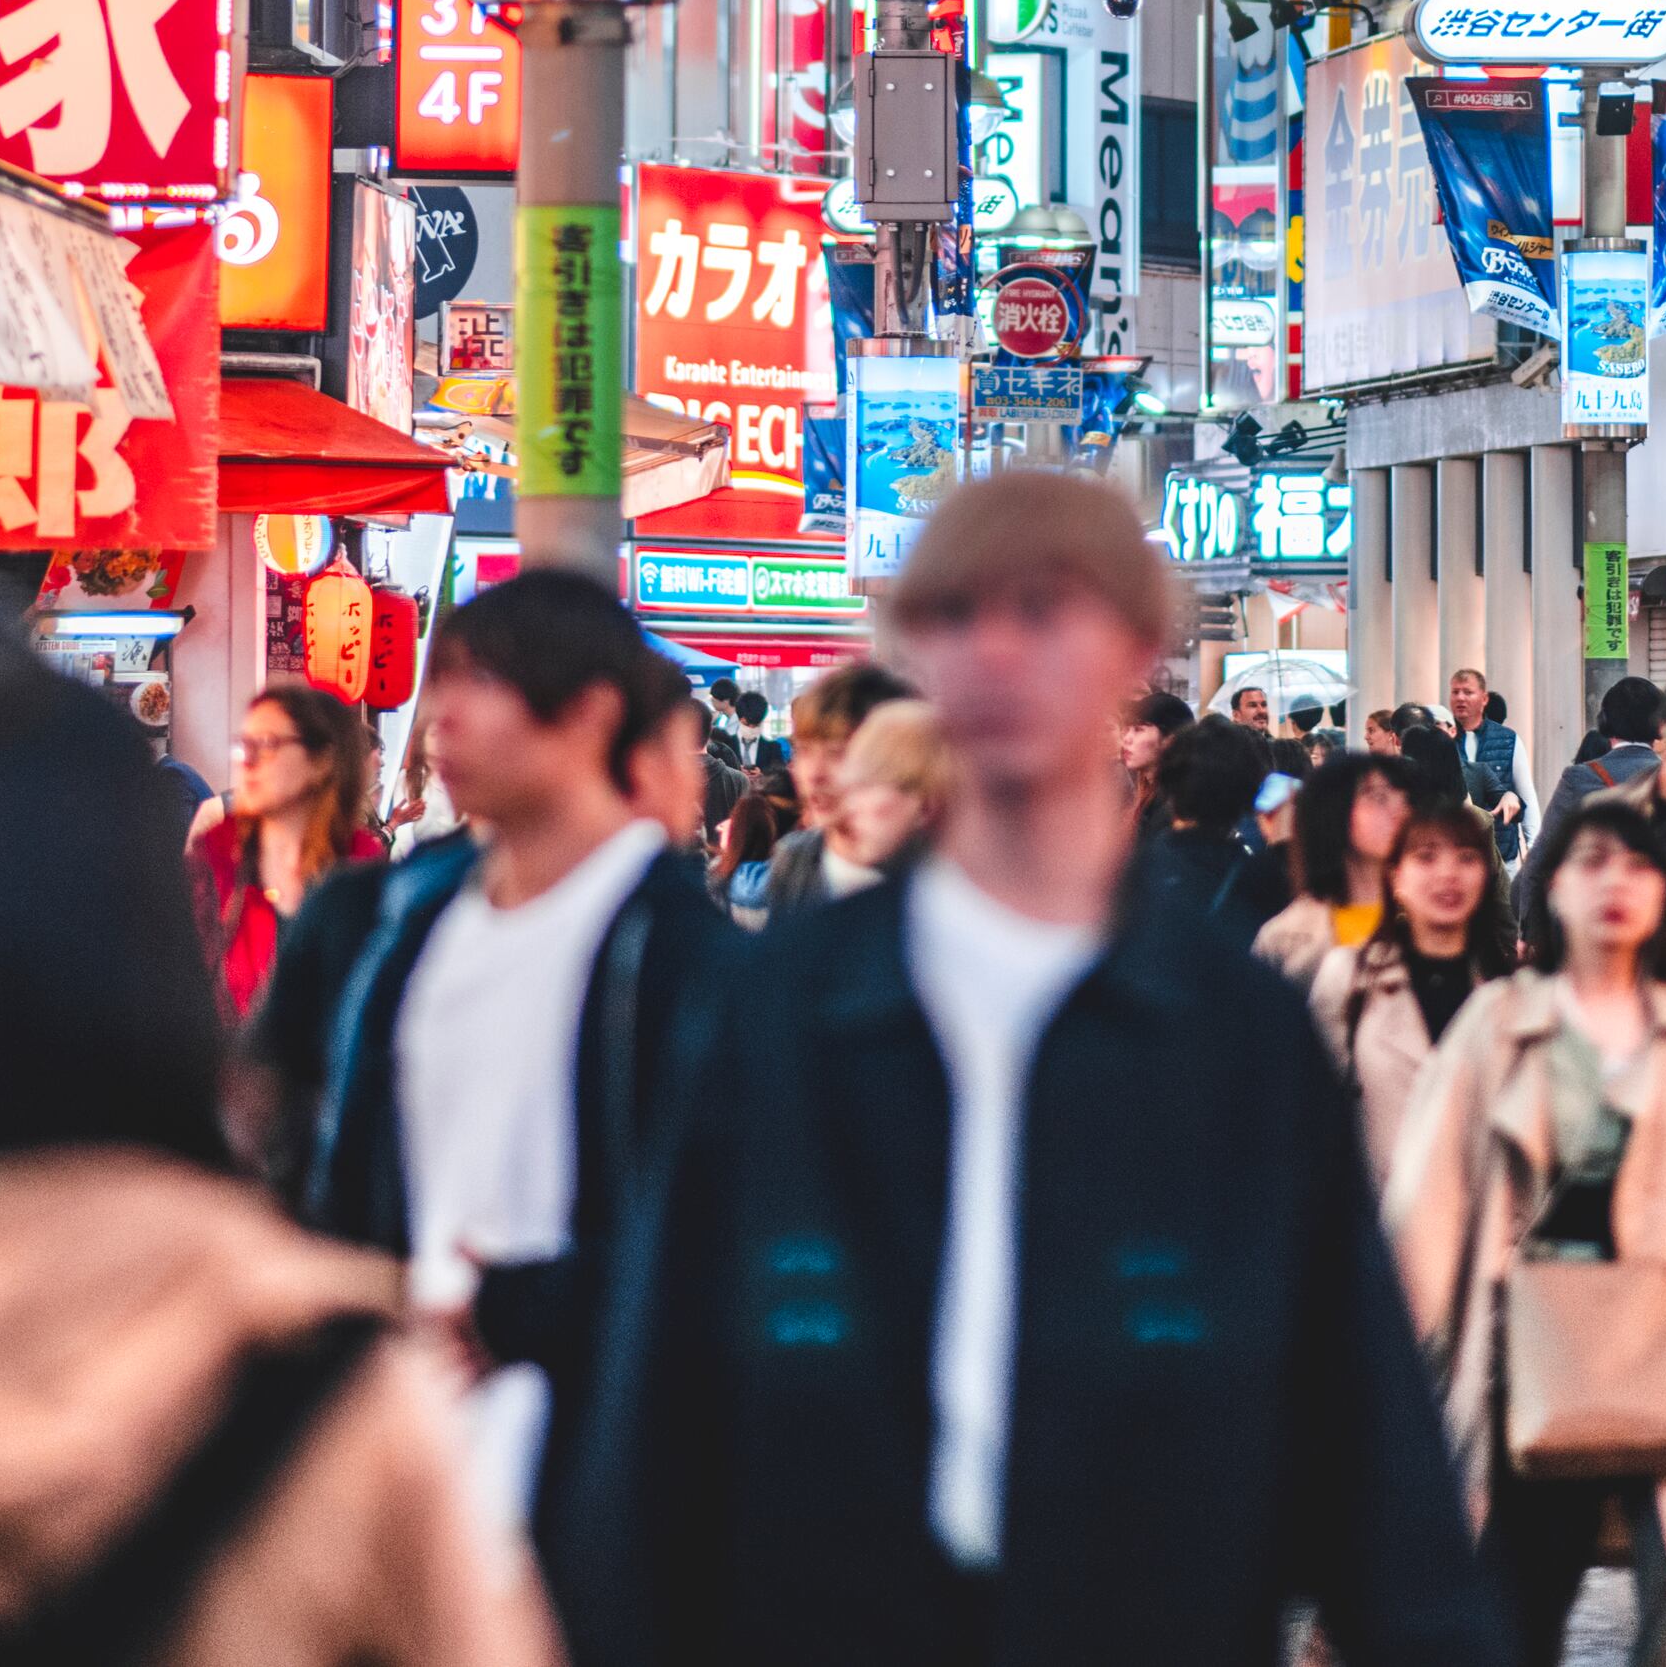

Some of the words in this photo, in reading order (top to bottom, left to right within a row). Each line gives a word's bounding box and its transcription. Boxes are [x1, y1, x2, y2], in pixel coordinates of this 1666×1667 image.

[418, 69, 504, 125] 4F
[1004, 288, 1020, 299] FIRE
[1021, 288, 1057, 300] HYDRANT
[998, 302, 1063, 334] 消火栓
[663, 353, 727, 383] Karaoke
[1596, 357, 1646, 376] SASEBO
[1575, 389, 1643, 411] 九十九島
[1163, 474, 1238, 562] くすりの
[340, 601, 361, 684] ホッピー
[374, 614, 394, 691] ホッピー
